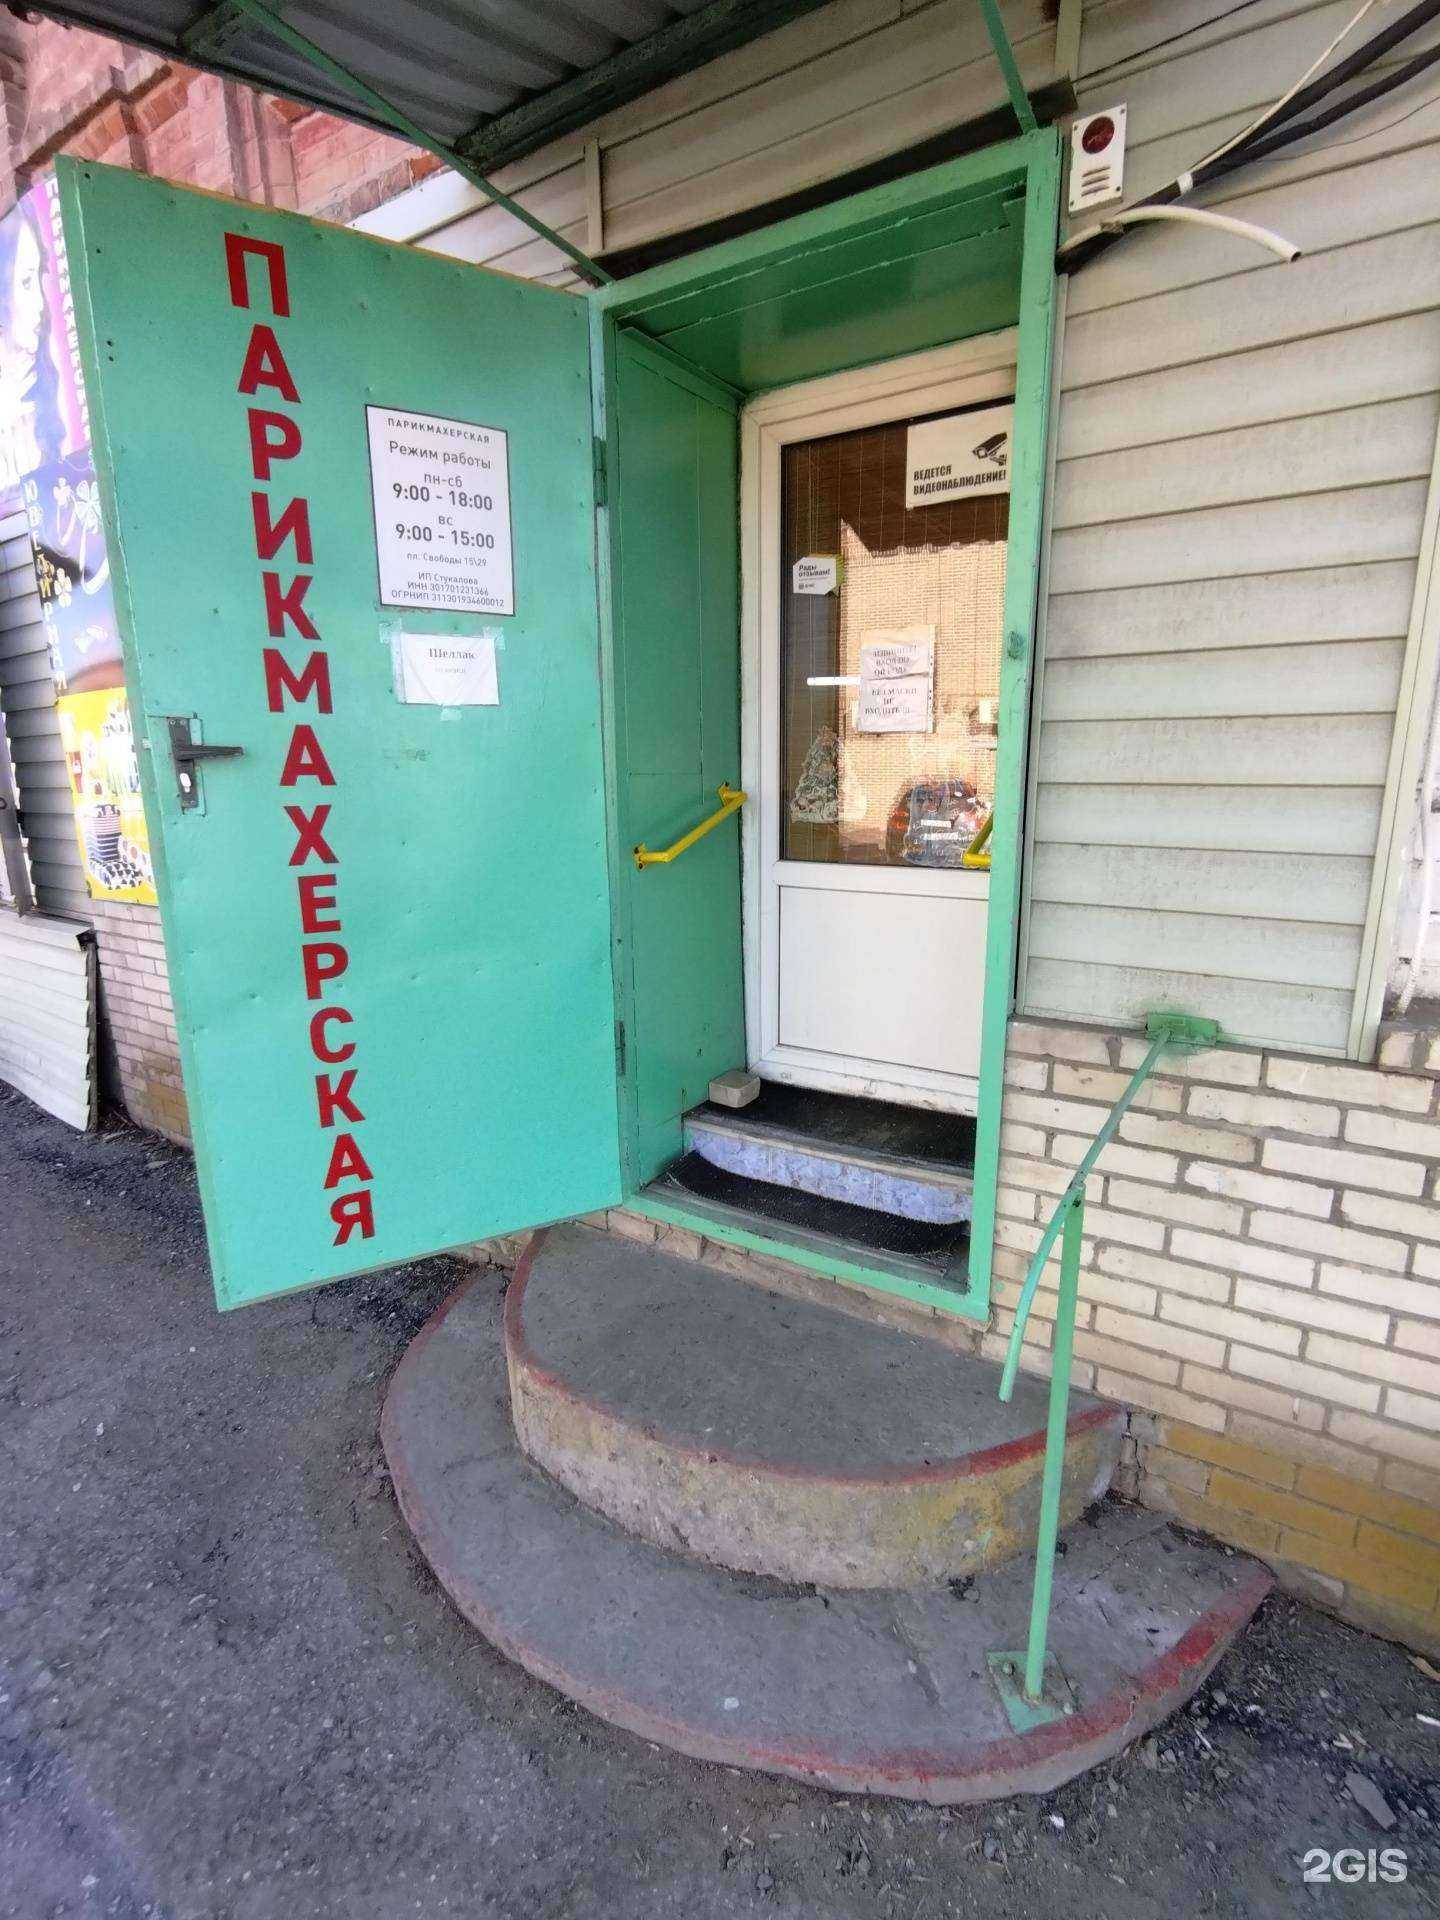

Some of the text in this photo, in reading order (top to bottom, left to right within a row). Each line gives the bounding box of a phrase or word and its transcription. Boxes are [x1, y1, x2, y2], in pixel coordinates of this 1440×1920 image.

[388, 418, 490, 443] ПАРИКМАХЕРСКАЯ
[389, 440, 491, 469] Режим работы
[424, 473, 463, 488] пн-сб
[913, 464, 952, 480] ВЕДЕТСЯ
[913, 469, 1007, 495] ВИДЕОНАБЛЮДЕНИЕ!
[393, 483, 430, 502] 9:00
[449, 490, 493, 511] 18:00
[395, 524, 432, 542] 9:00
[451, 530, 495, 549] 15:00
[407, 553, 421, 561] пл.
[423, 553, 461, 565] Свободы
[407, 581, 428, 590] ИНН
[418, 572, 478, 585] ИП Стукалова
[391, 589, 430, 600] ОГРНИП
[224, 232, 376, 1247] ПАРИКМАХЕРСКАЯ
